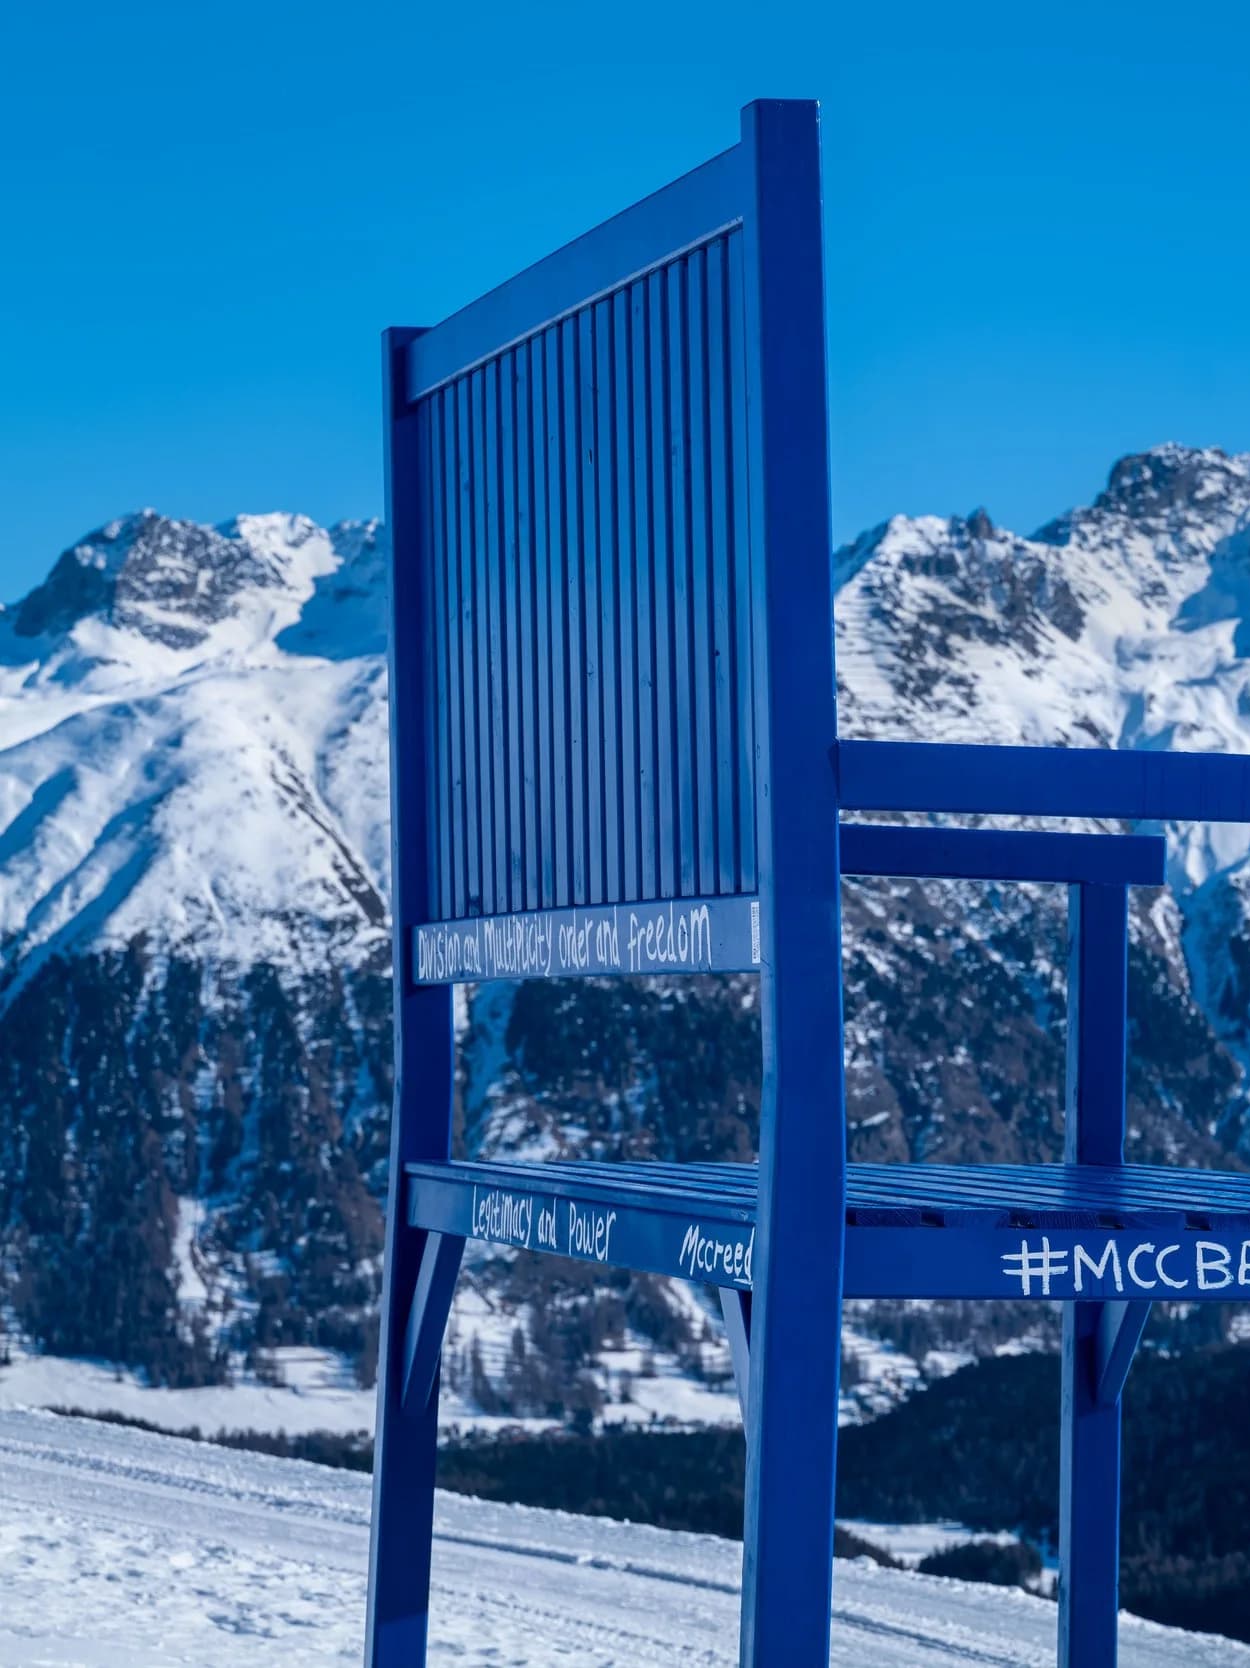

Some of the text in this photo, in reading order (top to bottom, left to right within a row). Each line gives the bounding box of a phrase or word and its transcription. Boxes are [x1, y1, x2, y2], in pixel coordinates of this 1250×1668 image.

[418, 923, 461, 980] Division
[463, 917, 482, 974] and
[558, 907, 593, 970] order
[596, 904, 621, 968] and
[472, 1184, 616, 1262] Legitimacy and Power
